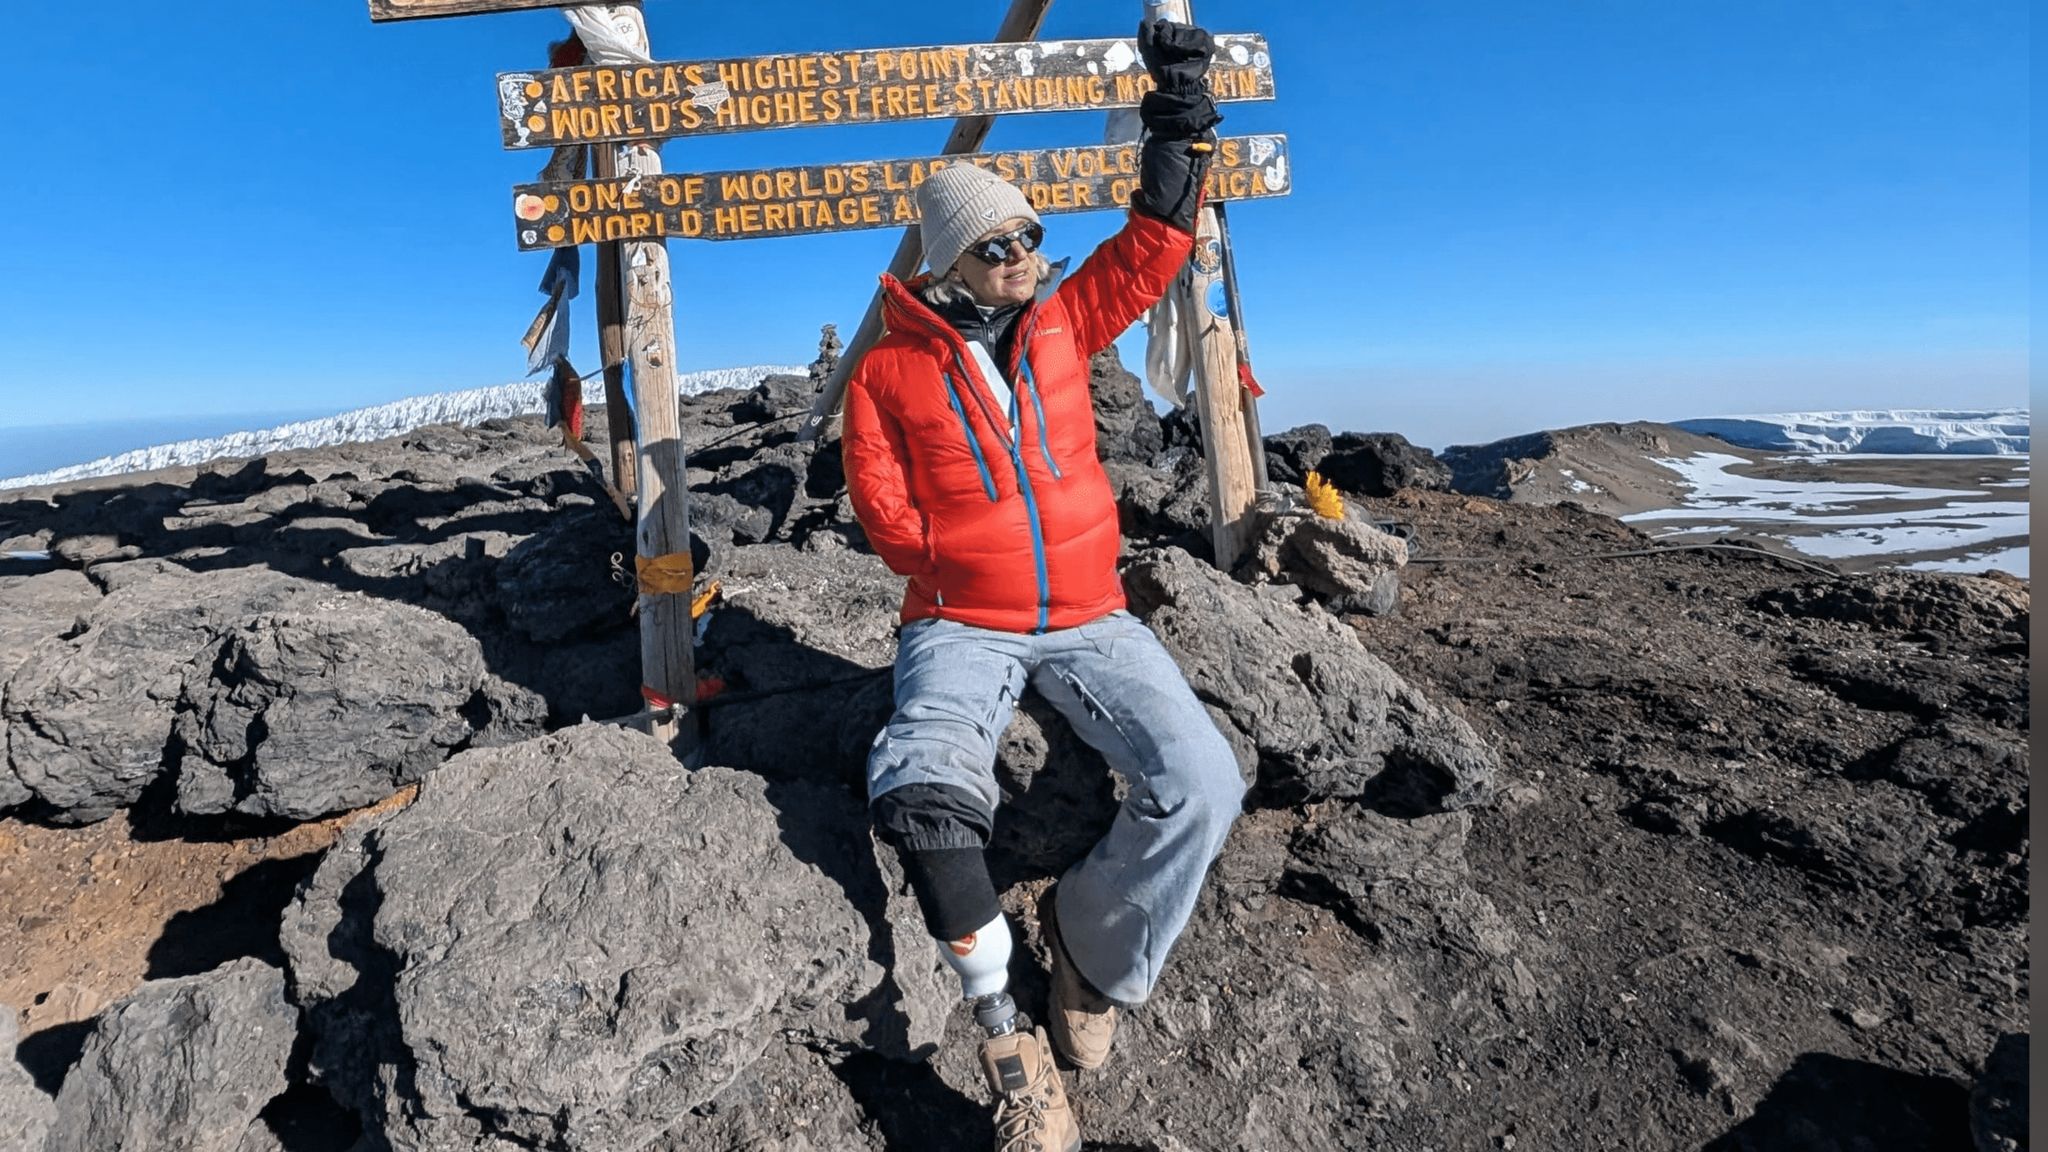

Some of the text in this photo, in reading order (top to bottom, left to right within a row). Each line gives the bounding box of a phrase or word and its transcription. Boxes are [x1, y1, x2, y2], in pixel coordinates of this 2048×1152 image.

[551, 65, 704, 103] AFRICA'S
[718, 54, 861, 91] HIGHEST
[875, 49, 968, 80] POINT
[552, 100, 702, 139] WORLD'S
[715, 90, 860, 126] HIGHEST
[1115, 68, 1258, 102] MOAIN
[570, 182, 644, 213] ONE
[660, 178, 704, 205] OF
[722, 165, 870, 200] WORLD'S
[1052, 140, 1240, 177] VOLCS
[715, 196, 881, 234] HERITAGE
